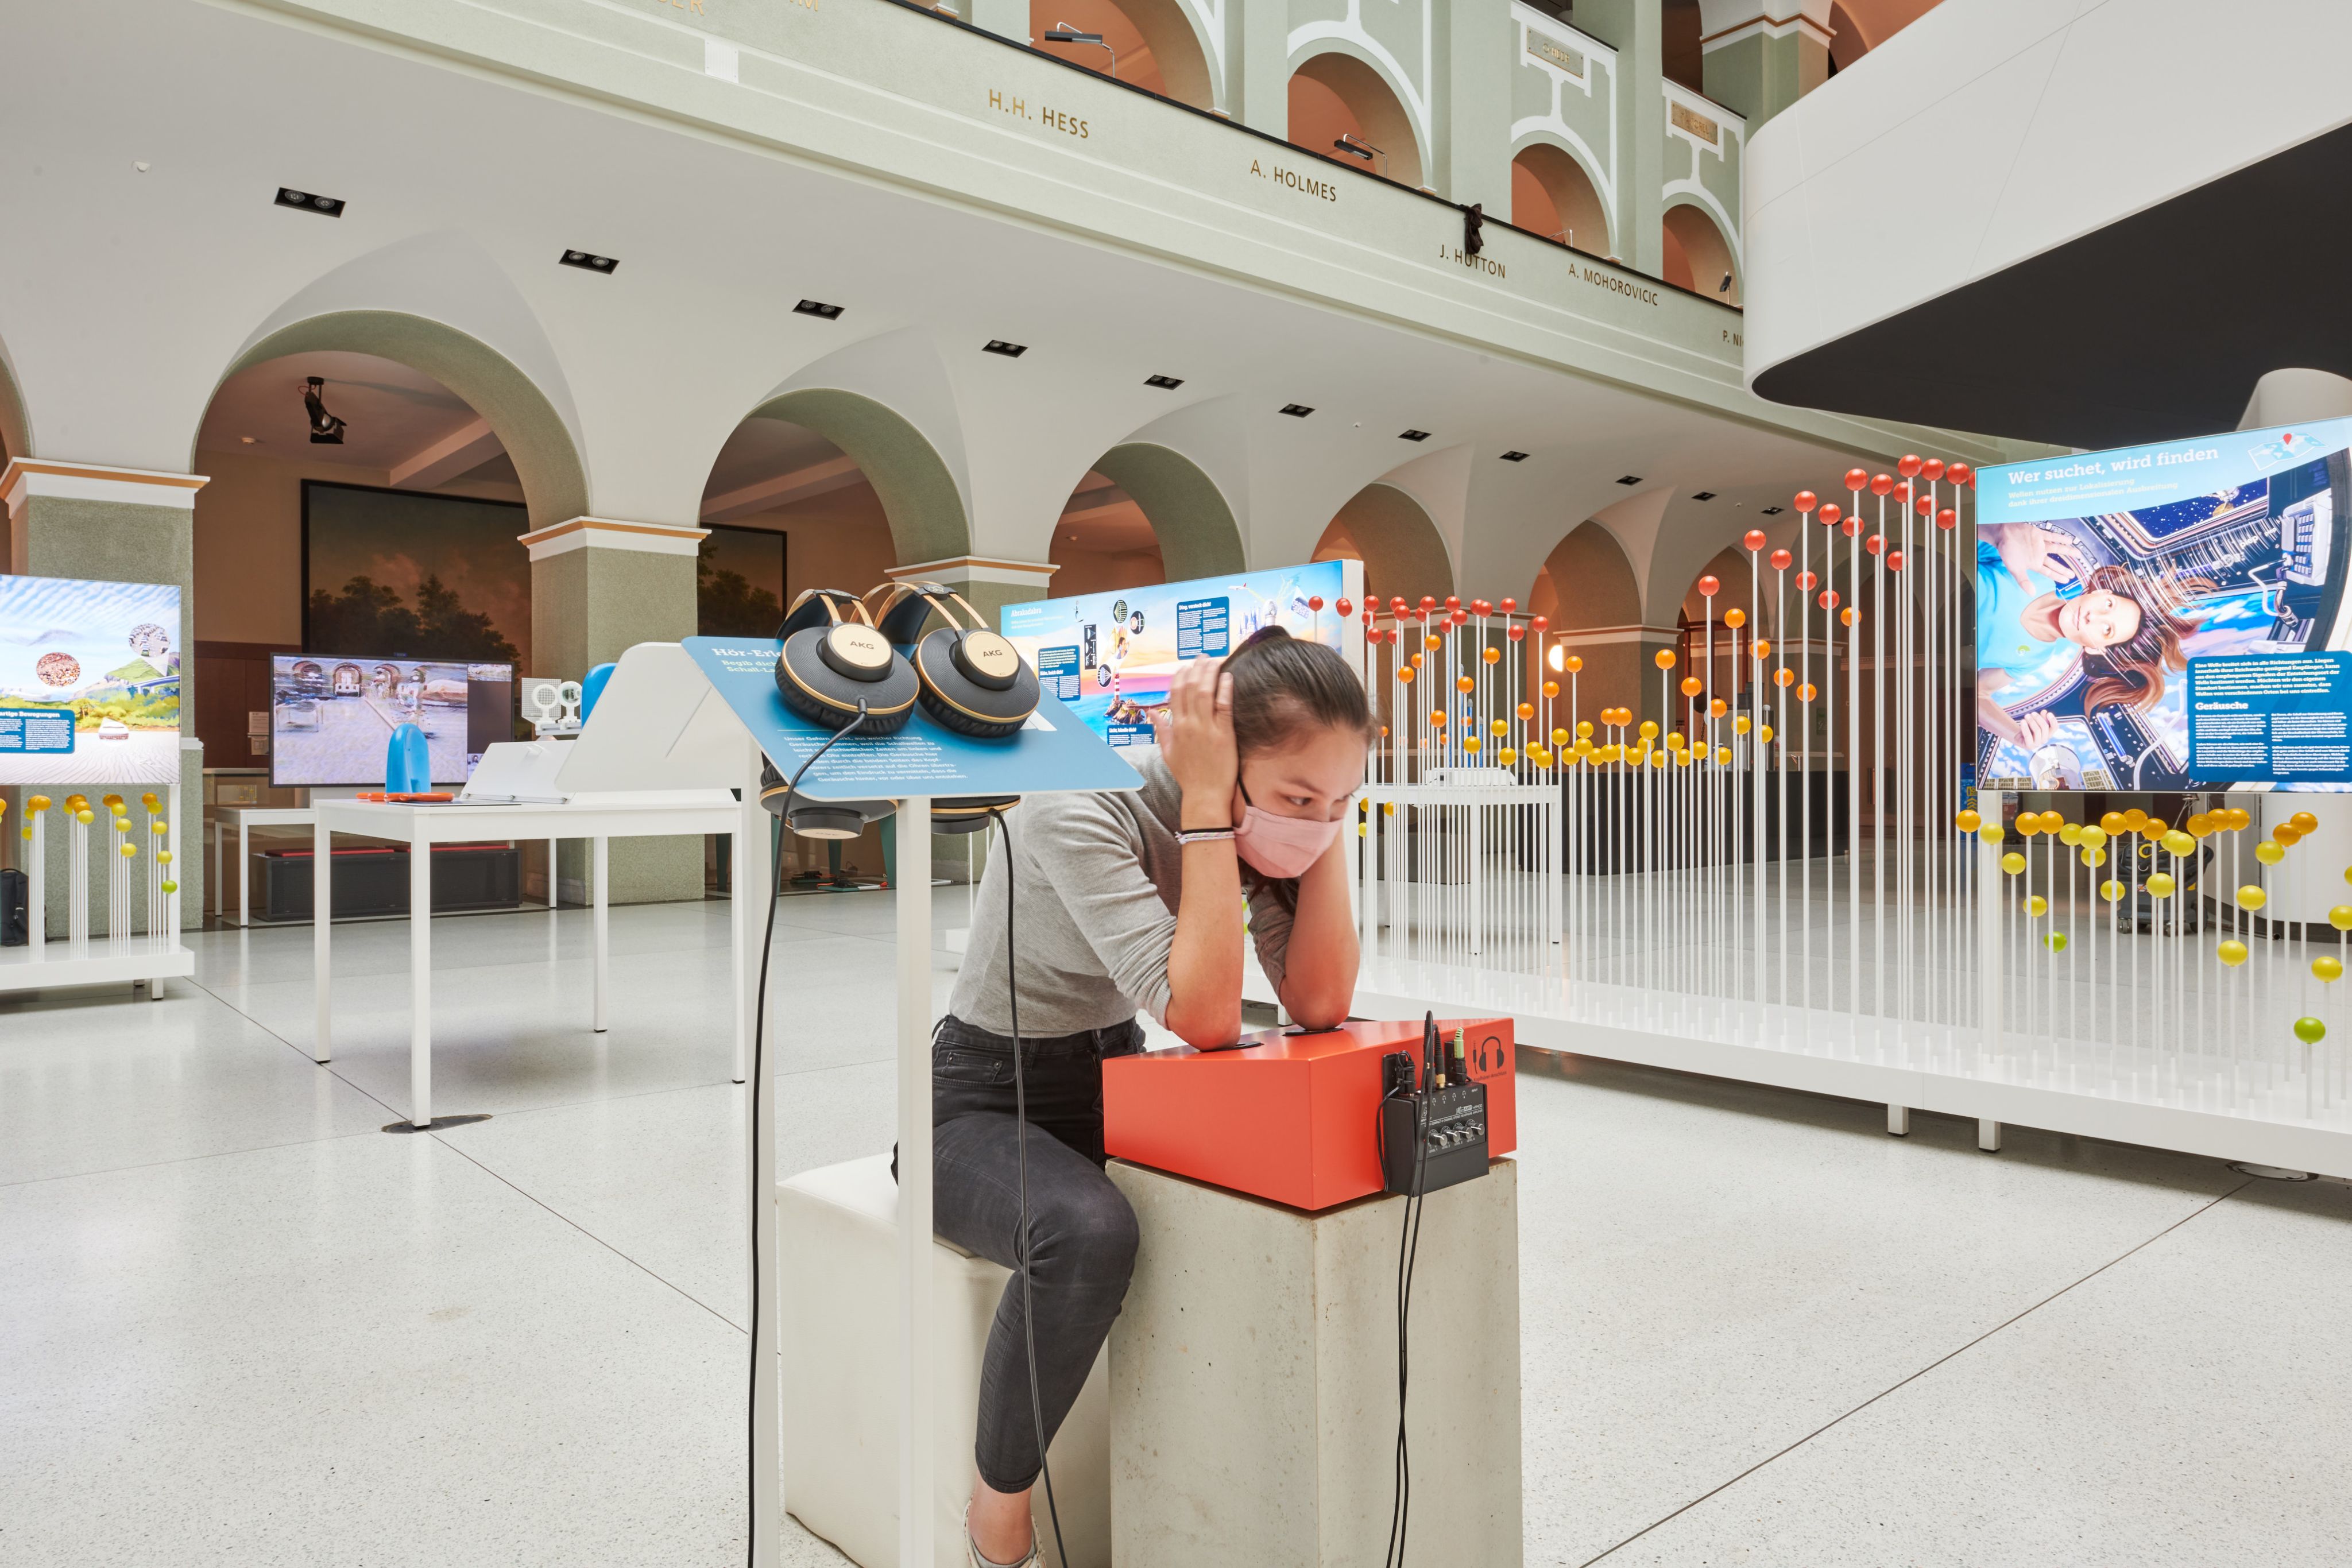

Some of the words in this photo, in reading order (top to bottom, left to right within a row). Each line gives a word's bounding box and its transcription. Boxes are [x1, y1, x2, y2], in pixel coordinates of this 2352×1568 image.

[989, 88, 1032, 121] H.H.
[1043, 106, 1089, 139] HESS
[1251, 159, 1266, 177] A.
[1274, 166, 1337, 202] HOLMES
[1440, 244, 1449, 260] J.
[1454, 249, 1506, 278] HUTTON
[1568, 263, 1580, 278] A.
[1584, 268, 1659, 307] MOHOROVICIC
[1723, 330, 1730, 343] P.
[1733, 333, 1744, 347] NI
[2008, 470, 2040, 485] Wer
[2044, 461, 2106, 481] suchet,
[2110, 452, 2151, 471] wird
[2156, 448, 2219, 466] finden
[2079, 479, 2135, 490] Lokalisierung
[2126, 482, 2178, 494] Ausbreitung
[1011, 607, 1042, 617] Abrakadabra
[850, 641, 875, 649] AKG
[983, 649, 1003, 657] AKG
[2195, 701, 2249, 711] Geräusche
